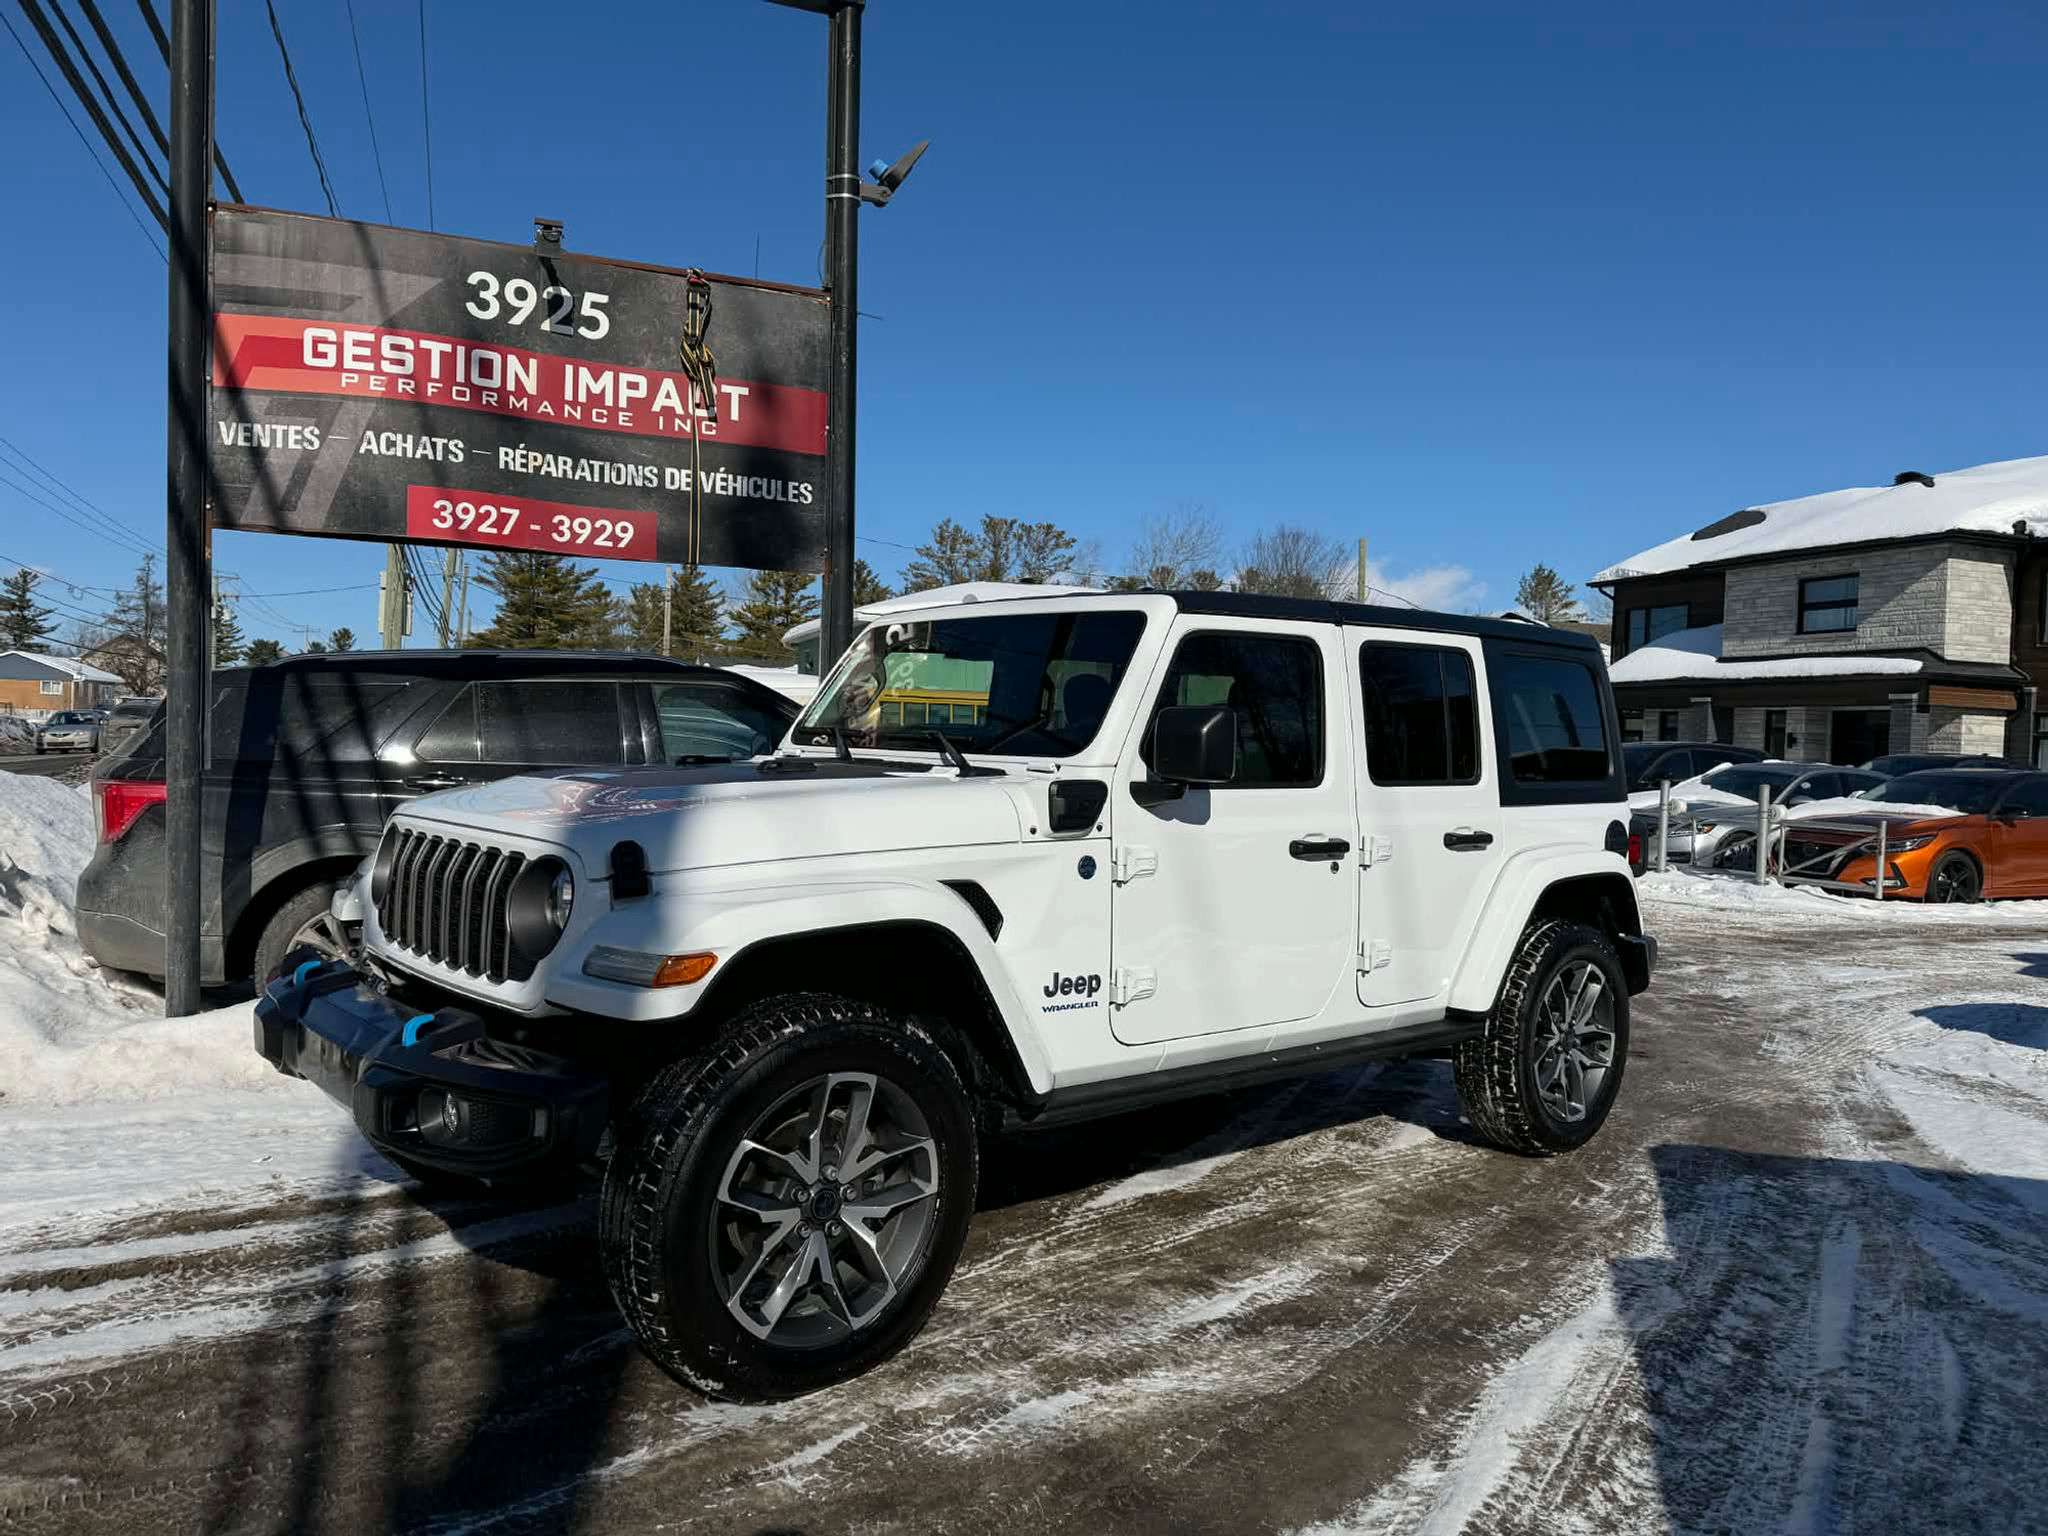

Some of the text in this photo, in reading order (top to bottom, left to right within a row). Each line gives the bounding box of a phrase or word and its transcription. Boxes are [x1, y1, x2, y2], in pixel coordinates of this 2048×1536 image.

[465, 271, 610, 340] 3925
[303, 327, 538, 396] GESTION
[341, 372, 717, 436] PERFORMANCE INC
[218, 420, 321, 451] VENTES
[359, 430, 465, 463] ACHATS
[498, 444, 659, 489] RÉPARATIONS
[665, 467, 693, 493] DE
[699, 466, 813, 505] VÉHICULES
[431, 499, 520, 536] 3927
[551, 514, 634, 549] 3929
[1041, 1001, 1098, 1013] WRANGLER
[1043, 972, 1101, 998] Jeep
